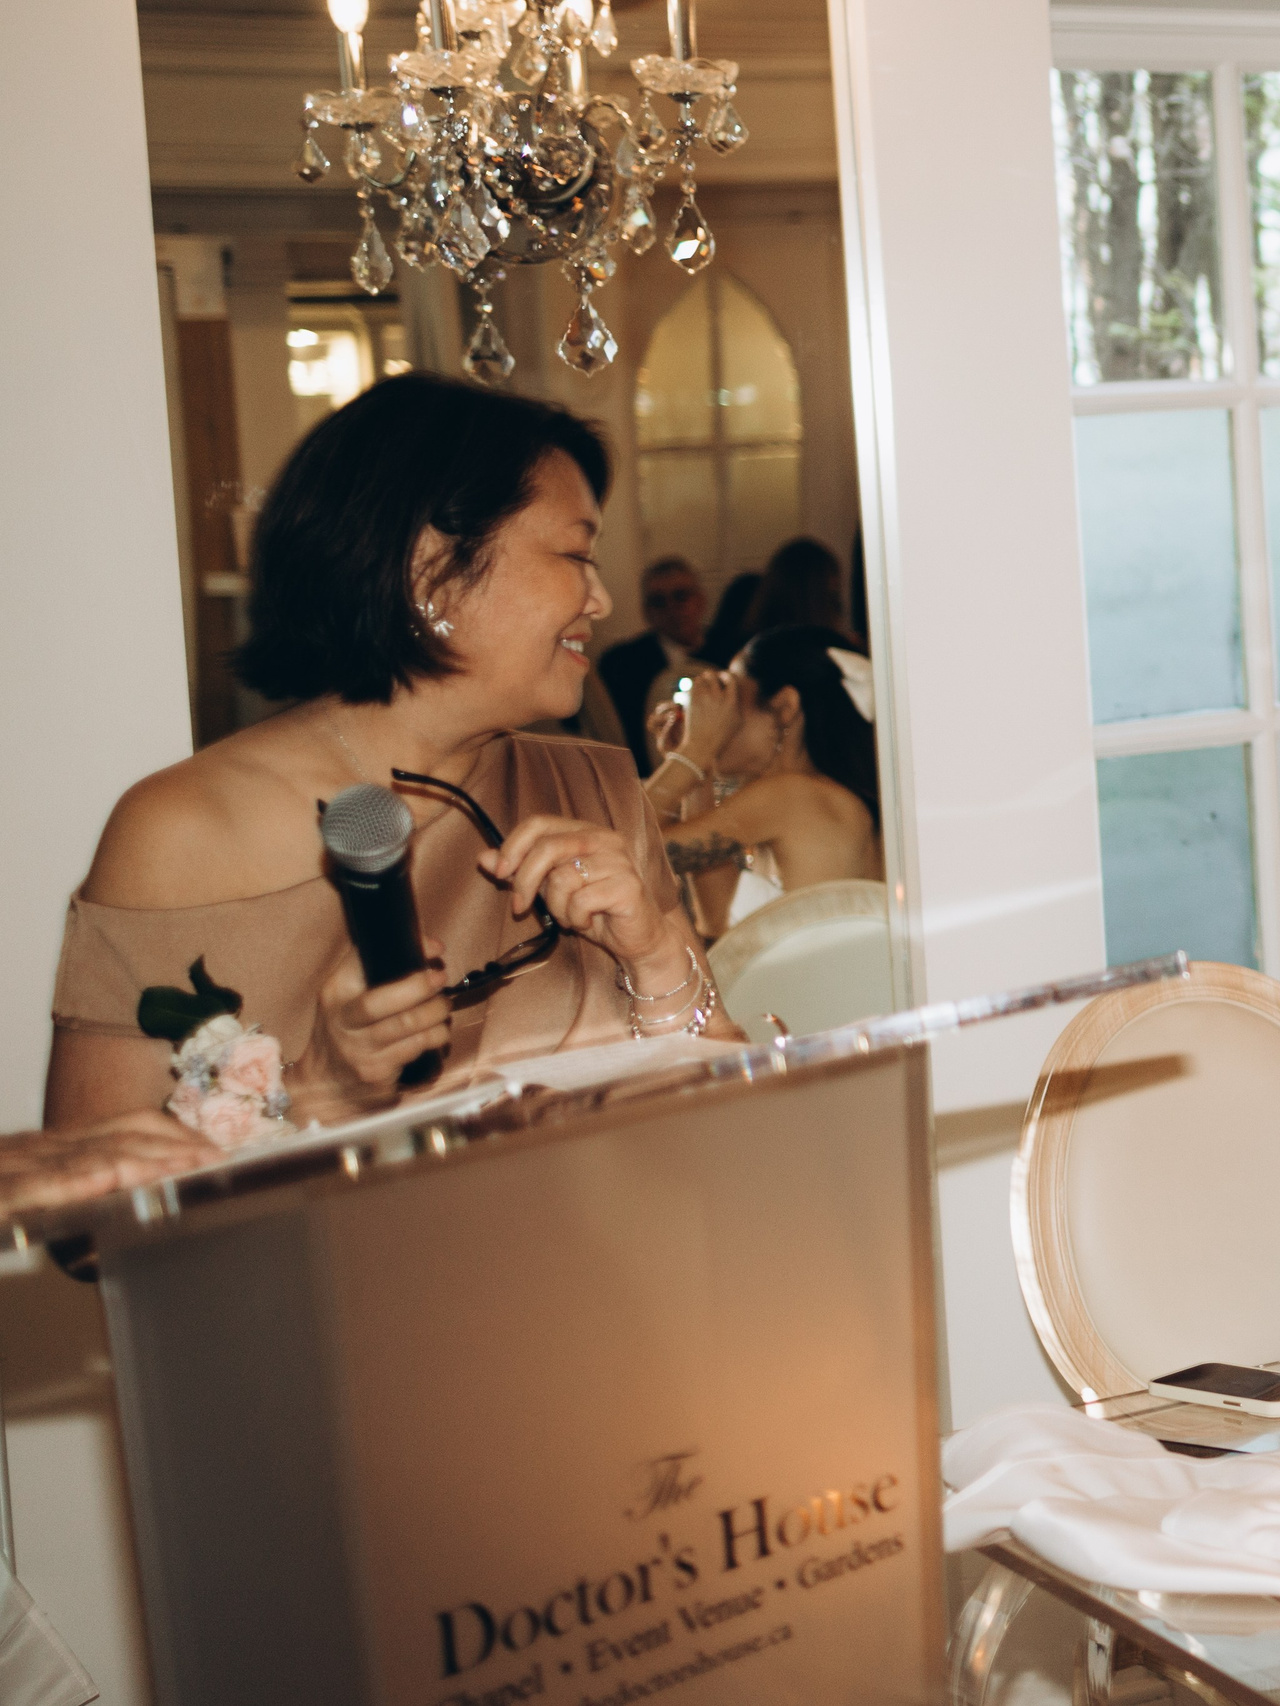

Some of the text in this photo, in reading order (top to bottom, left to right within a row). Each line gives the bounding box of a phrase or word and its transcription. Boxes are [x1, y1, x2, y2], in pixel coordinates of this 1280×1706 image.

[623, 1447, 704, 1523] The
[435, 1472, 899, 1680] Doctor's House
[586, 1618, 671, 1674] Event
[678, 1586, 764, 1634] Venue
[796, 1531, 906, 1591] Gardens
